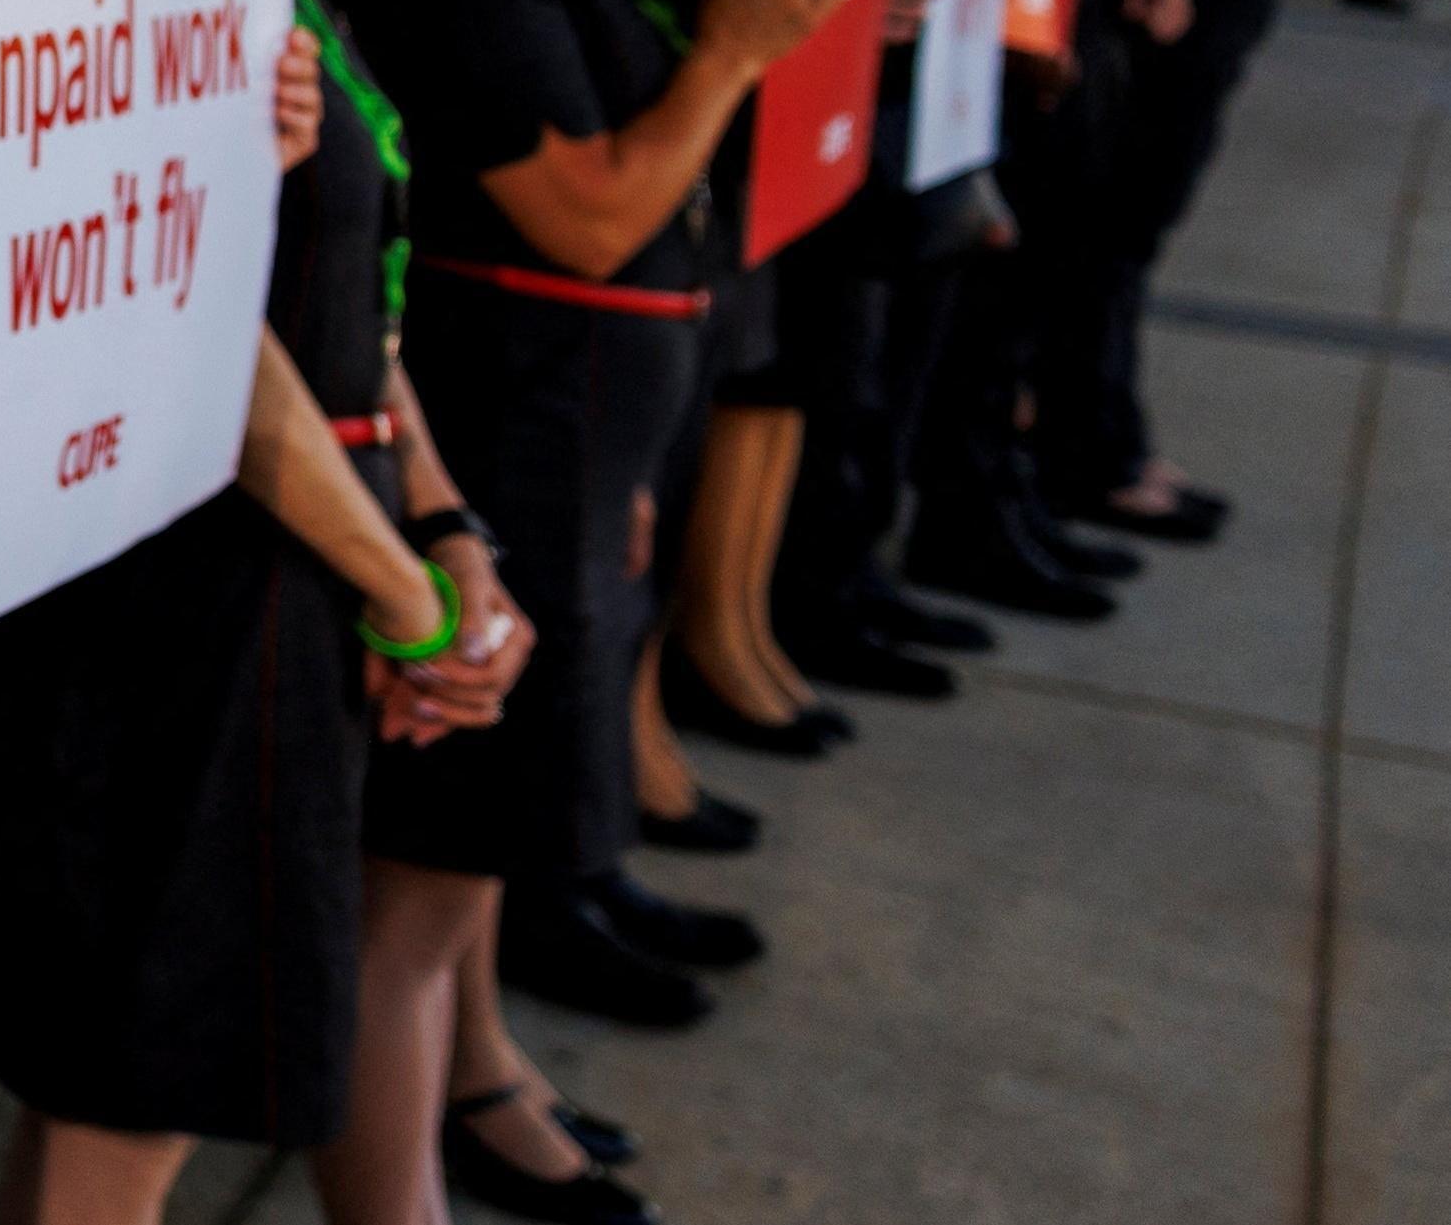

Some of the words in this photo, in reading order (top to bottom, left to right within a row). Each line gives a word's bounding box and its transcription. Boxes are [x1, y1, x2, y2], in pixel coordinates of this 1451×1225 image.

[8, 172, 143, 334] won't
[153, 153, 207, 310] fly
[56, 413, 124, 490] CUPE
